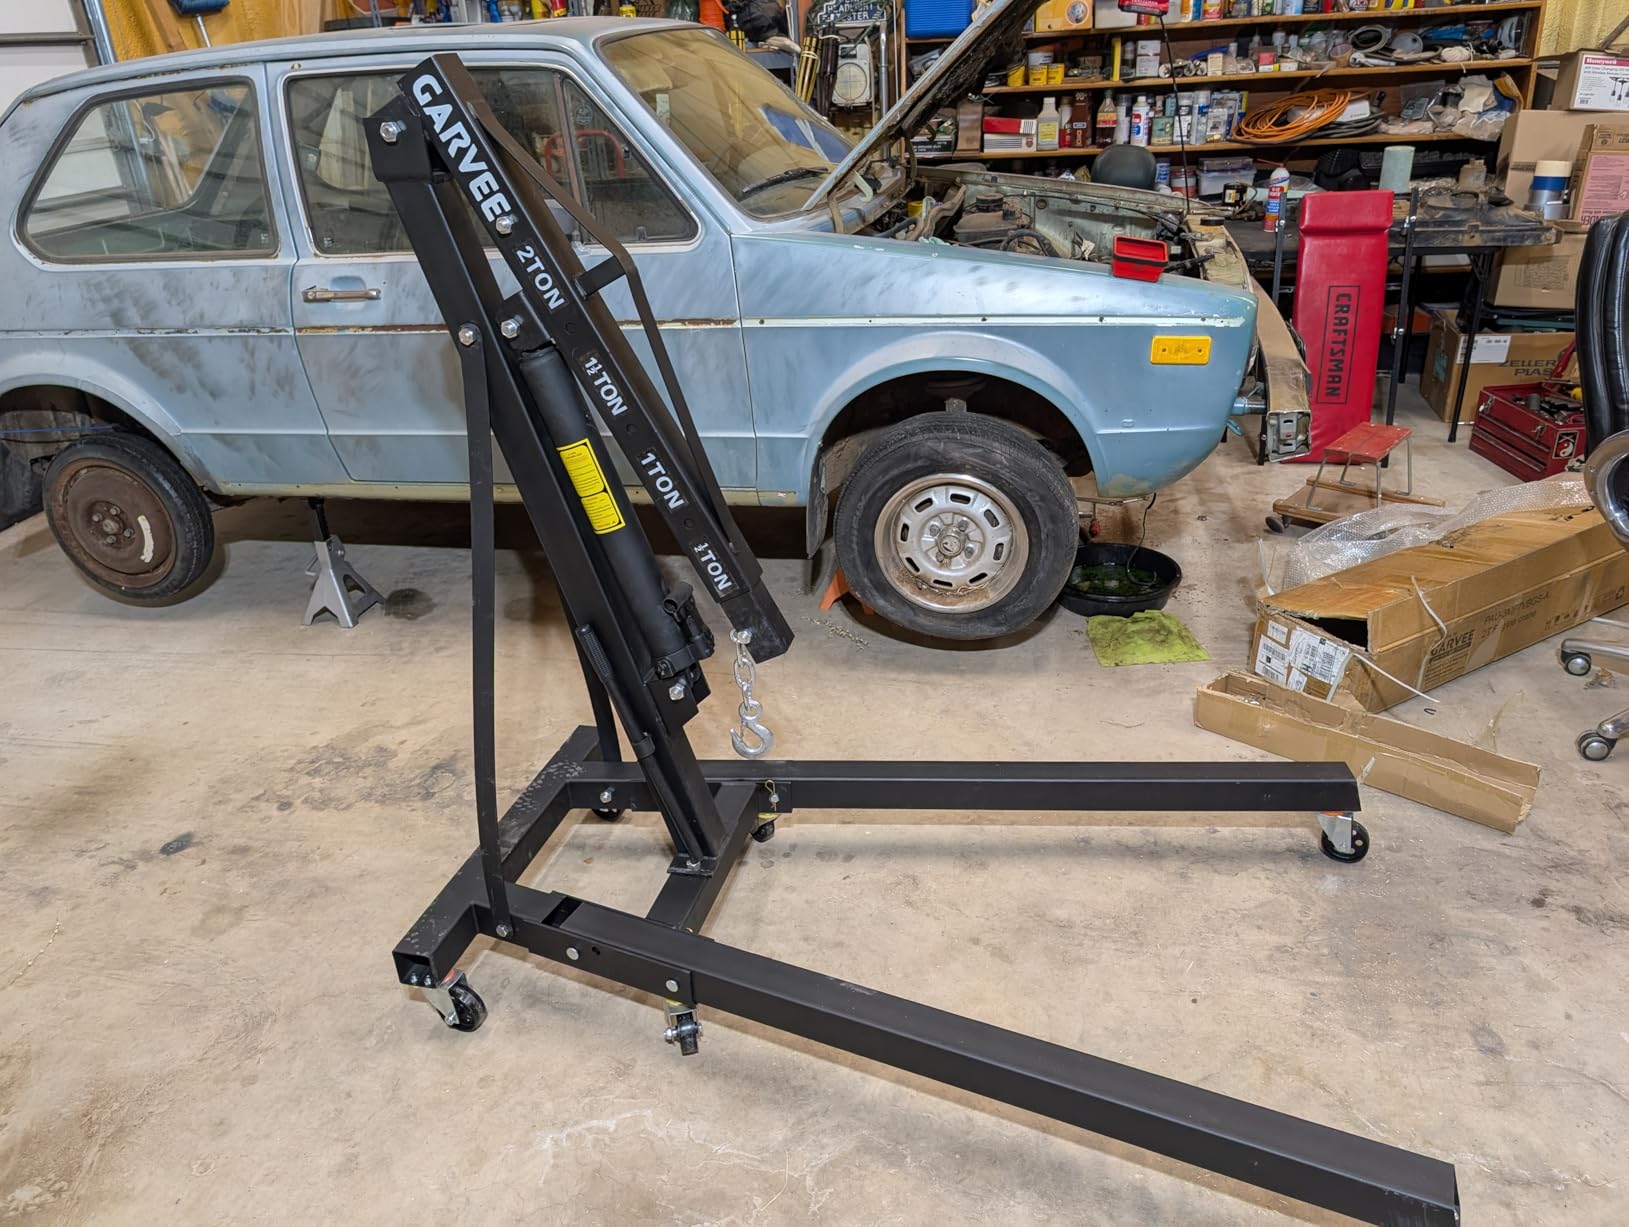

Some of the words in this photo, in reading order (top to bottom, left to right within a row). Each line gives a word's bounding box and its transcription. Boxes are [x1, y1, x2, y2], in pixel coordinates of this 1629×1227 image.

[412, 74, 512, 223] GARVEE
[1325, 293, 1352, 397] CRAFTSMAN
[1514, 368, 1554, 376] PLAS
